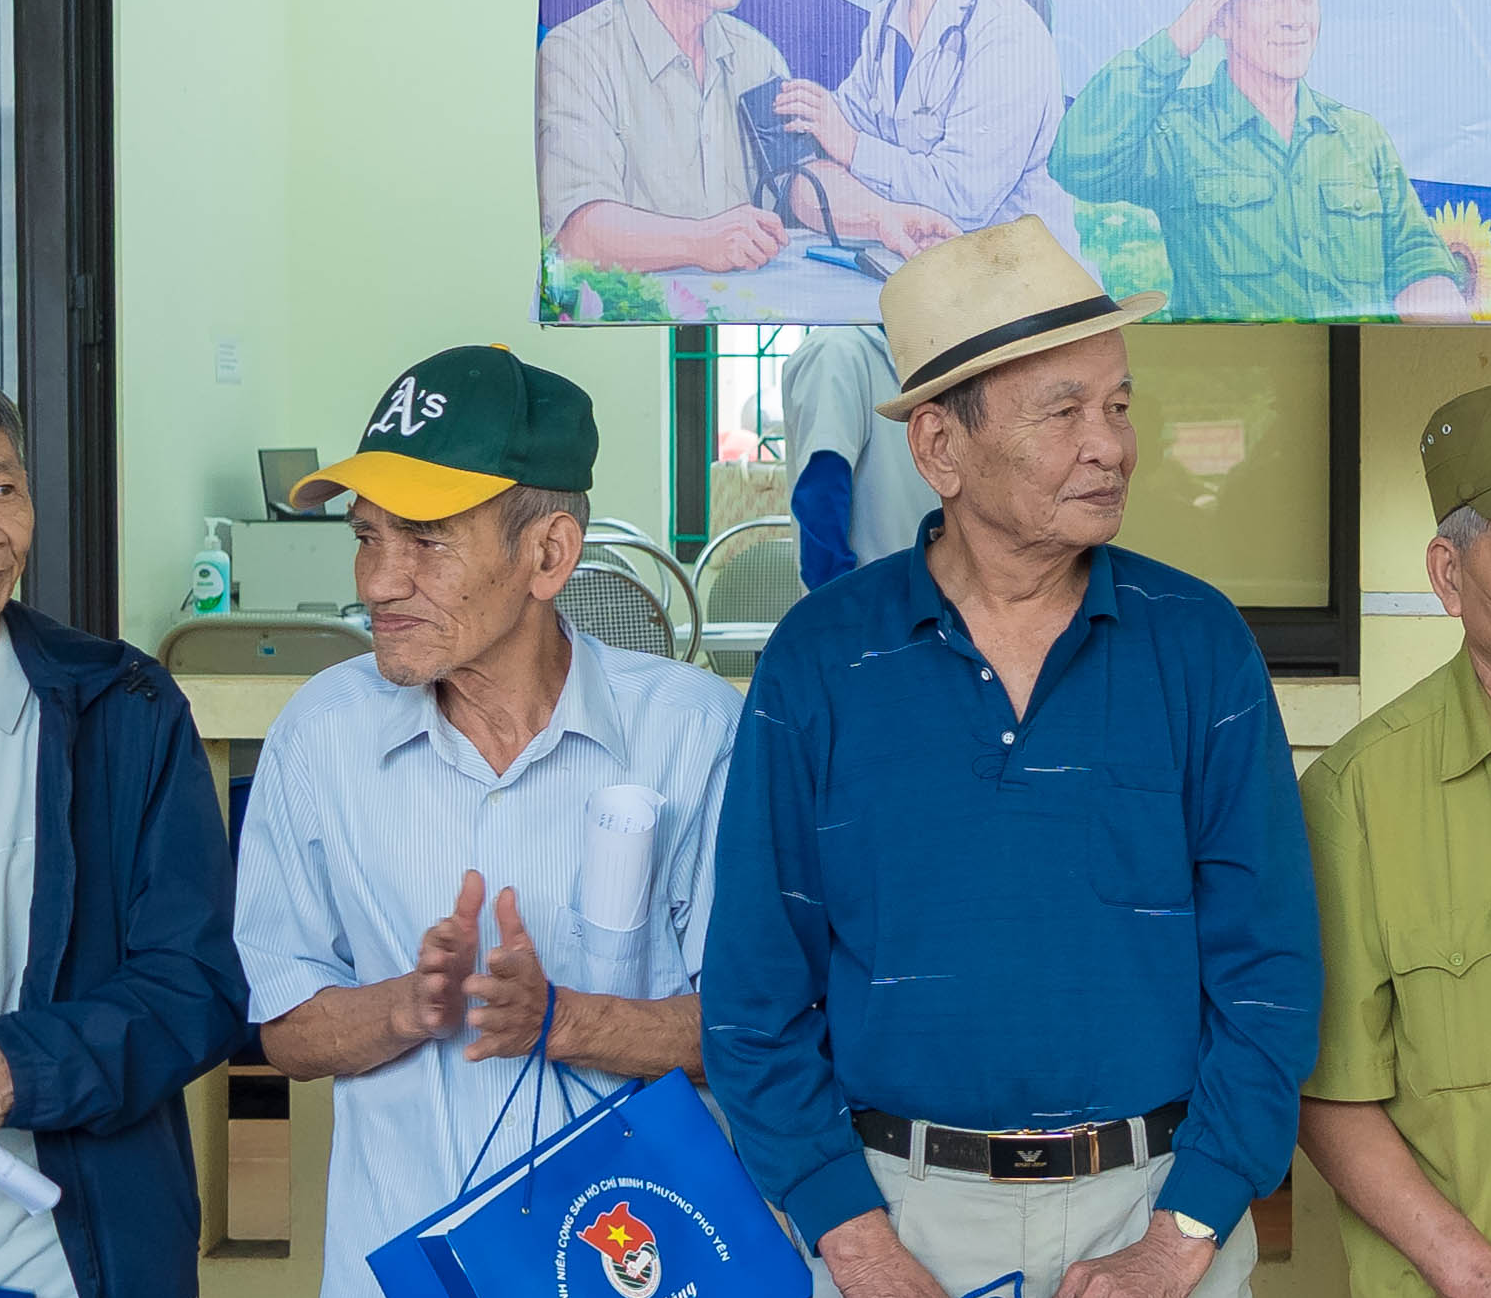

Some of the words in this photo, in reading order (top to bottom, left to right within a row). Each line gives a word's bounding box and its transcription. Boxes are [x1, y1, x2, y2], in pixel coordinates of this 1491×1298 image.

[555, 1250, 566, 1280] NIÊN
[618, 1178, 643, 1189] MINH
[713, 1236, 730, 1262] YÊN
